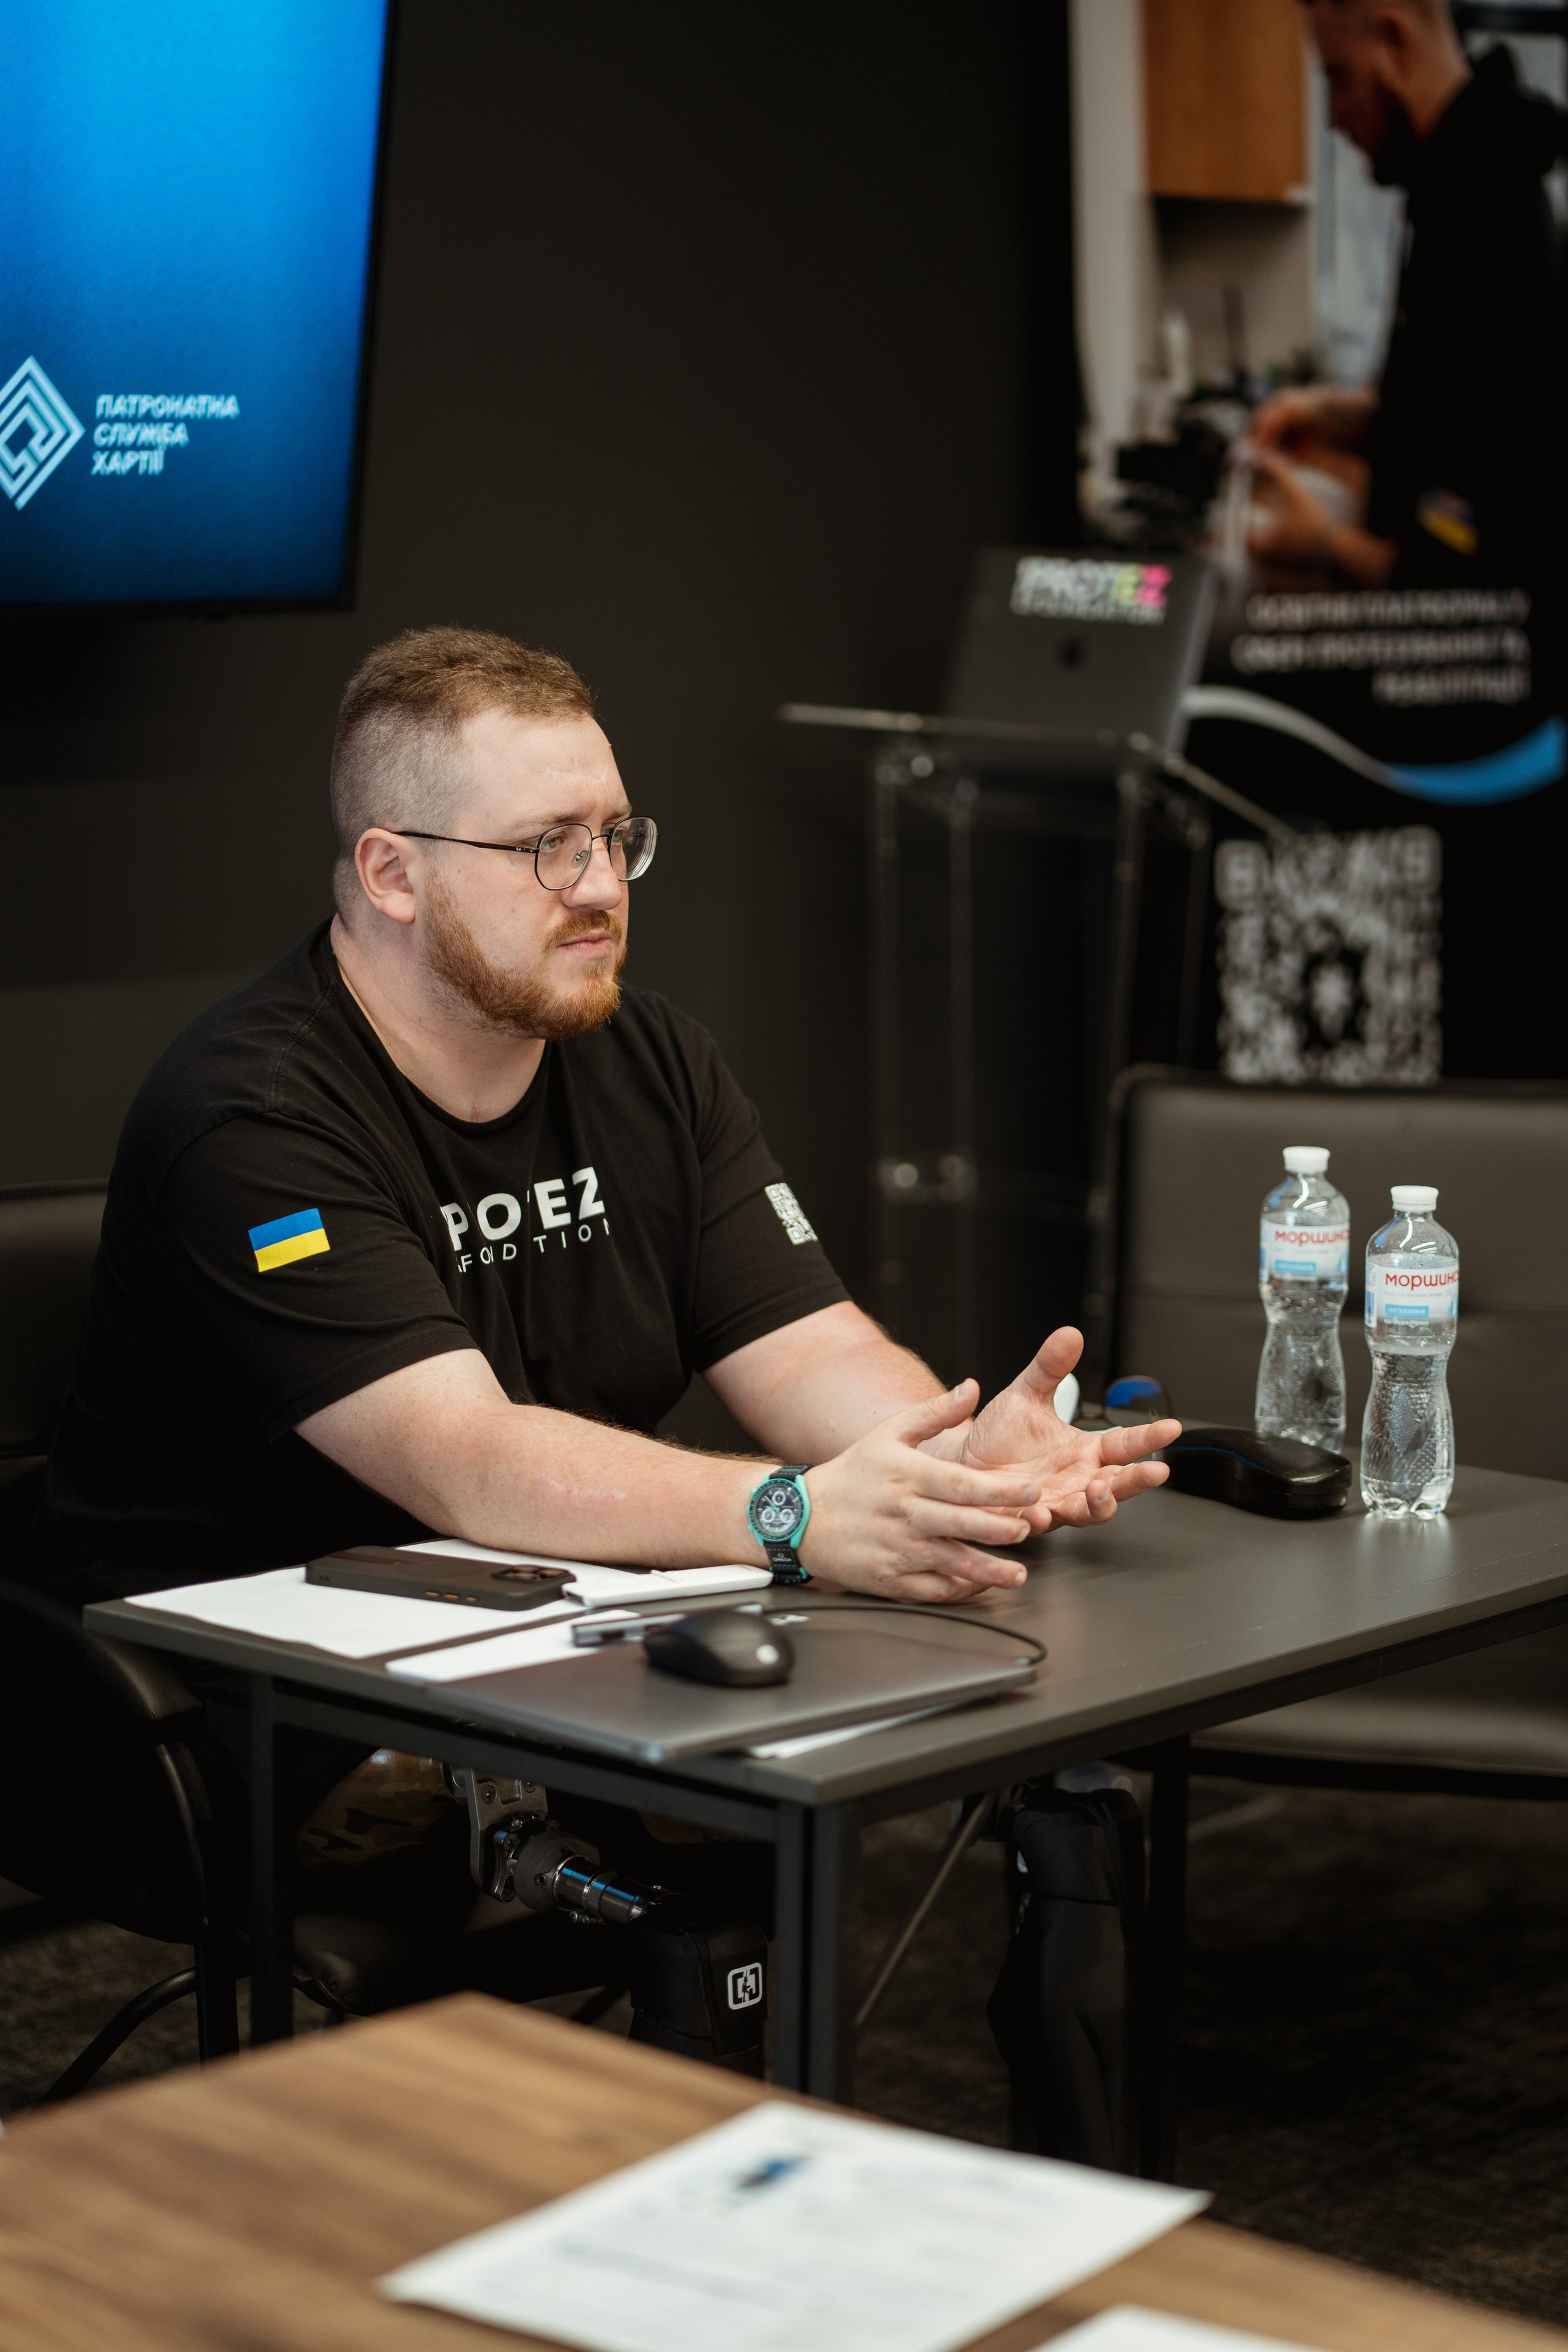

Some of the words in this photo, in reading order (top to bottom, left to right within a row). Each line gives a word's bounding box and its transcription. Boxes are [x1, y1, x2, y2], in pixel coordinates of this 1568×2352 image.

[96, 394, 240, 419] ПАТРОНАТНА
[93, 422, 189, 447] СЛУЖБА
[91, 445, 167, 475] ХАРТІЇ
[440, 1166, 605, 1251] POEZ
